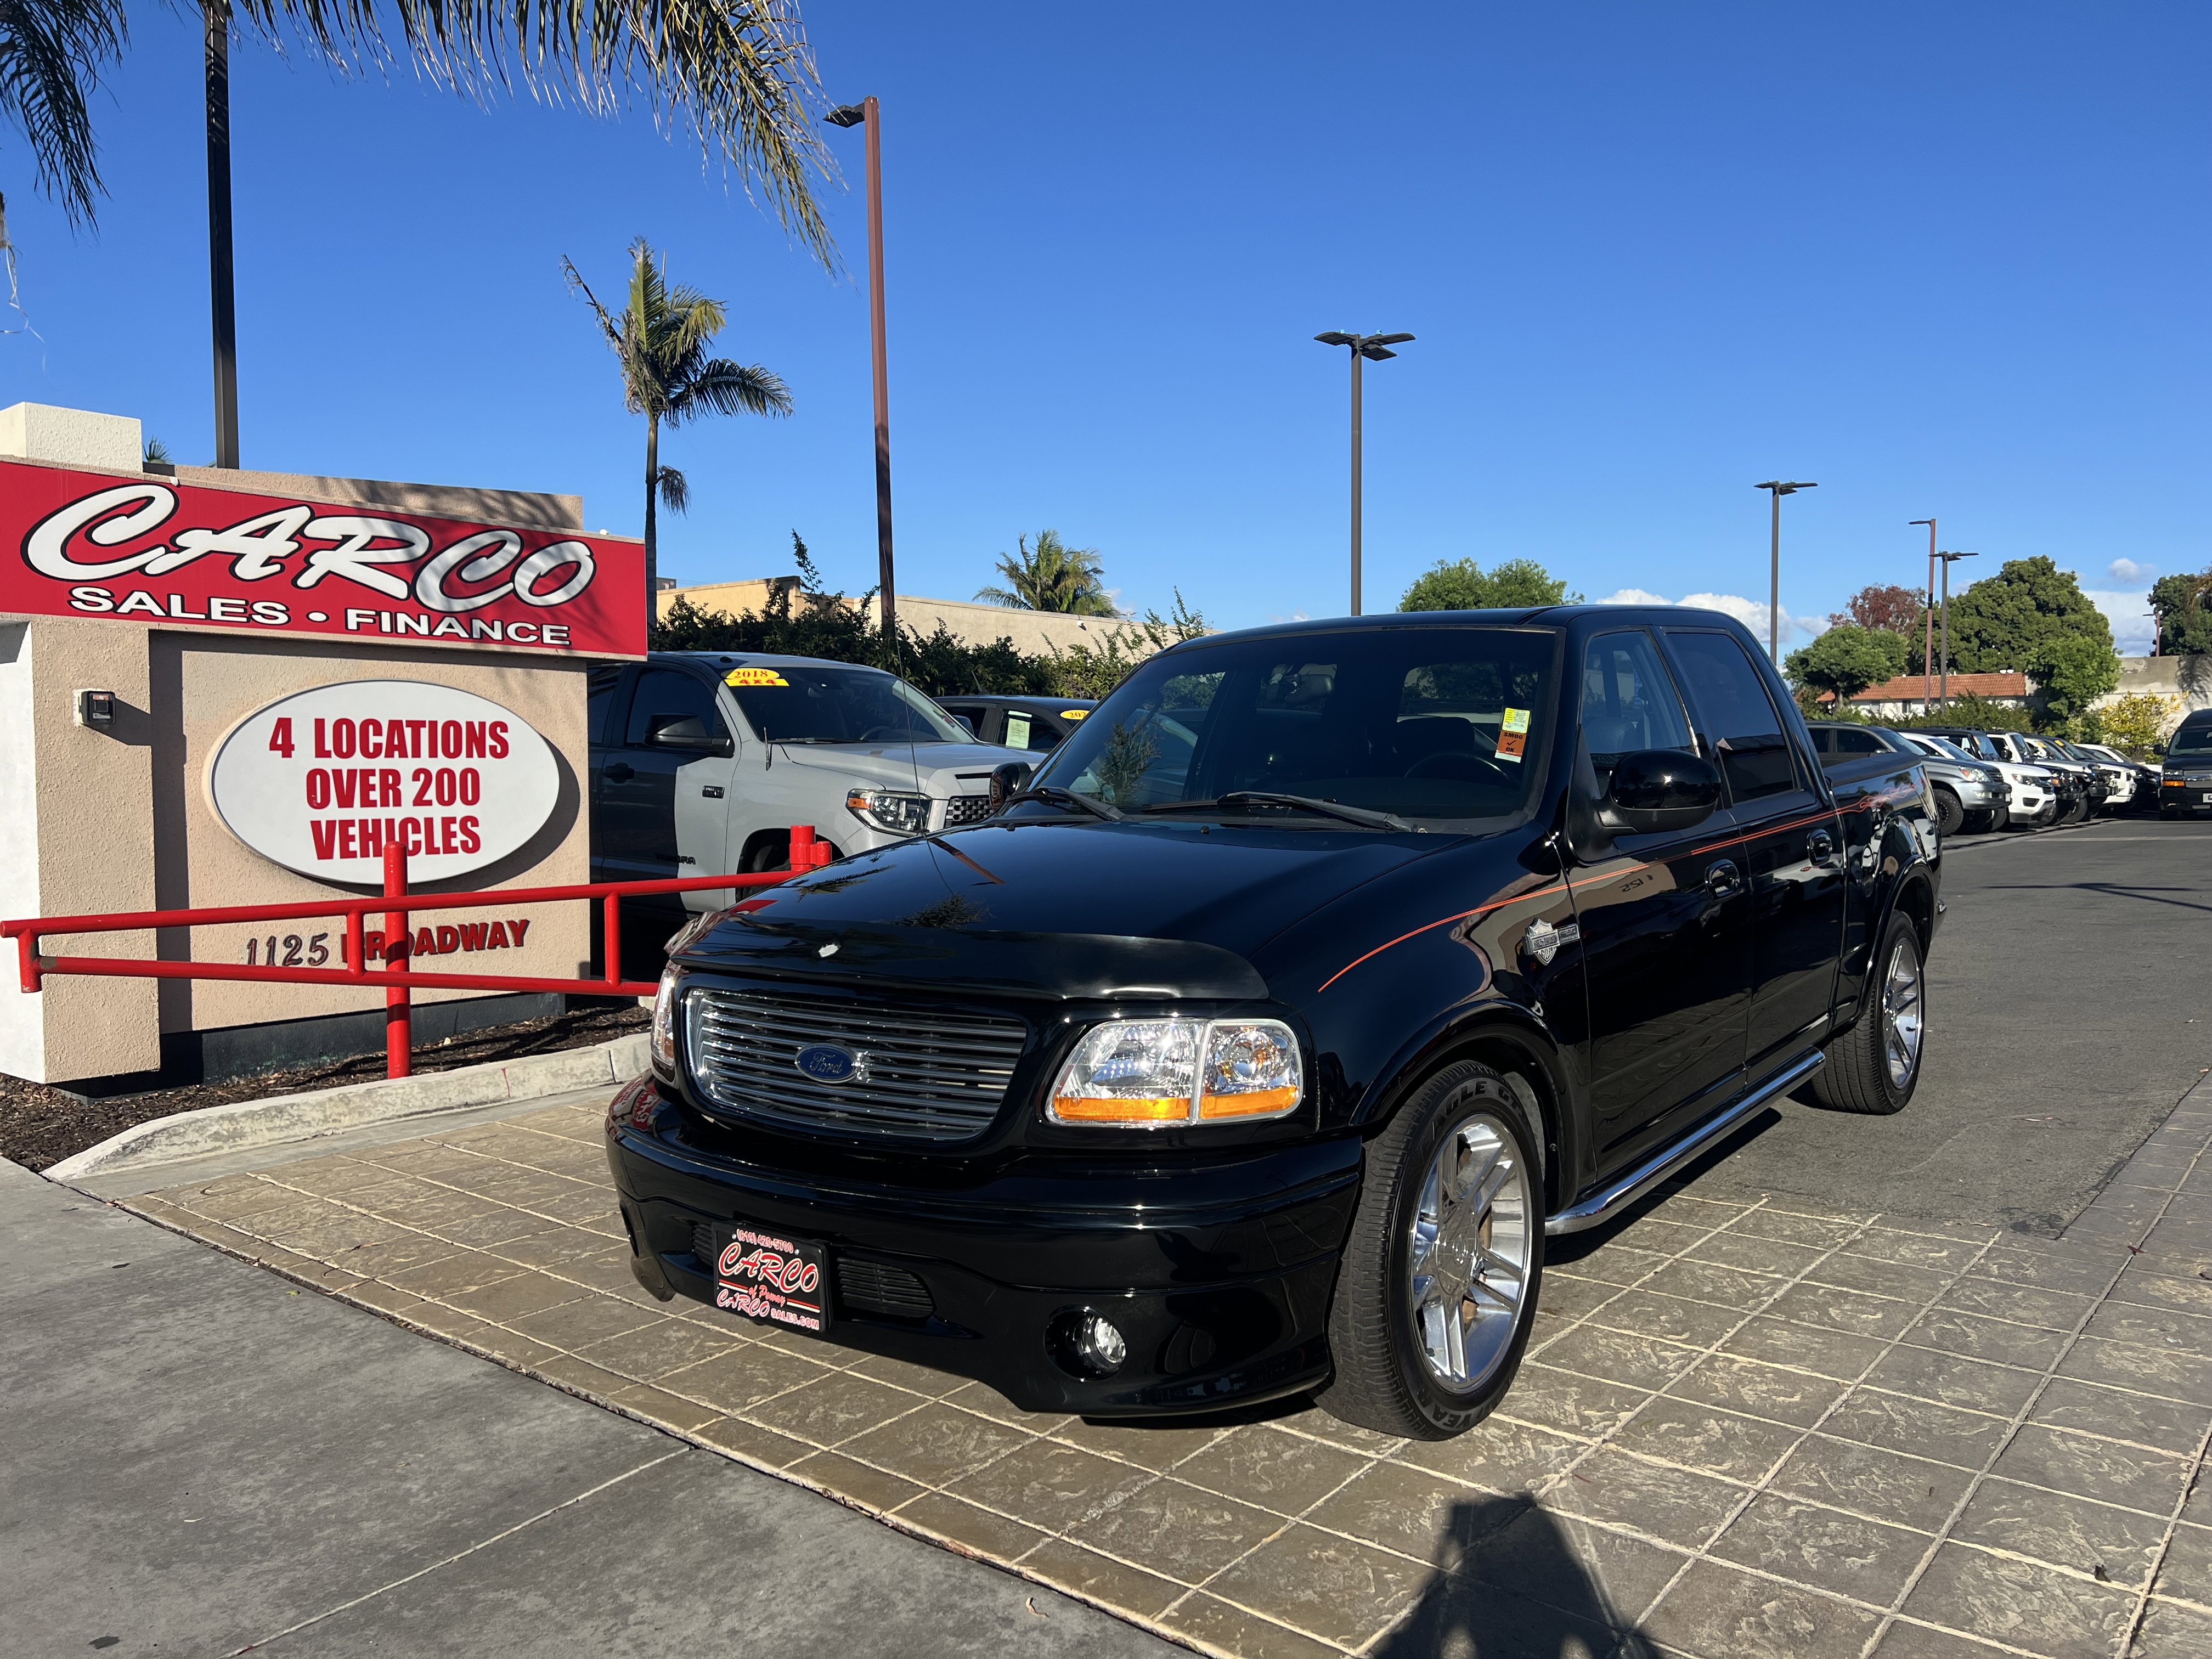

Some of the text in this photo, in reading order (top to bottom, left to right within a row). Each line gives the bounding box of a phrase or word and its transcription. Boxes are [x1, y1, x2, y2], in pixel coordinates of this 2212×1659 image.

[20, 483, 597, 613] CARCO
[67, 585, 571, 646] SALES FINANCE
[269, 718, 509, 759] 4 LOCATIONS
[306, 767, 481, 809] OVER 200
[310, 815, 481, 860] VEHICLES
[246, 932, 329, 967] 1125
[809, 1051, 844, 1074] Ford
[736, 1228, 794, 1254] (619) 420-5700
[719, 1242, 819, 1294] CARCO
[716, 1289, 770, 1317] CARCO
